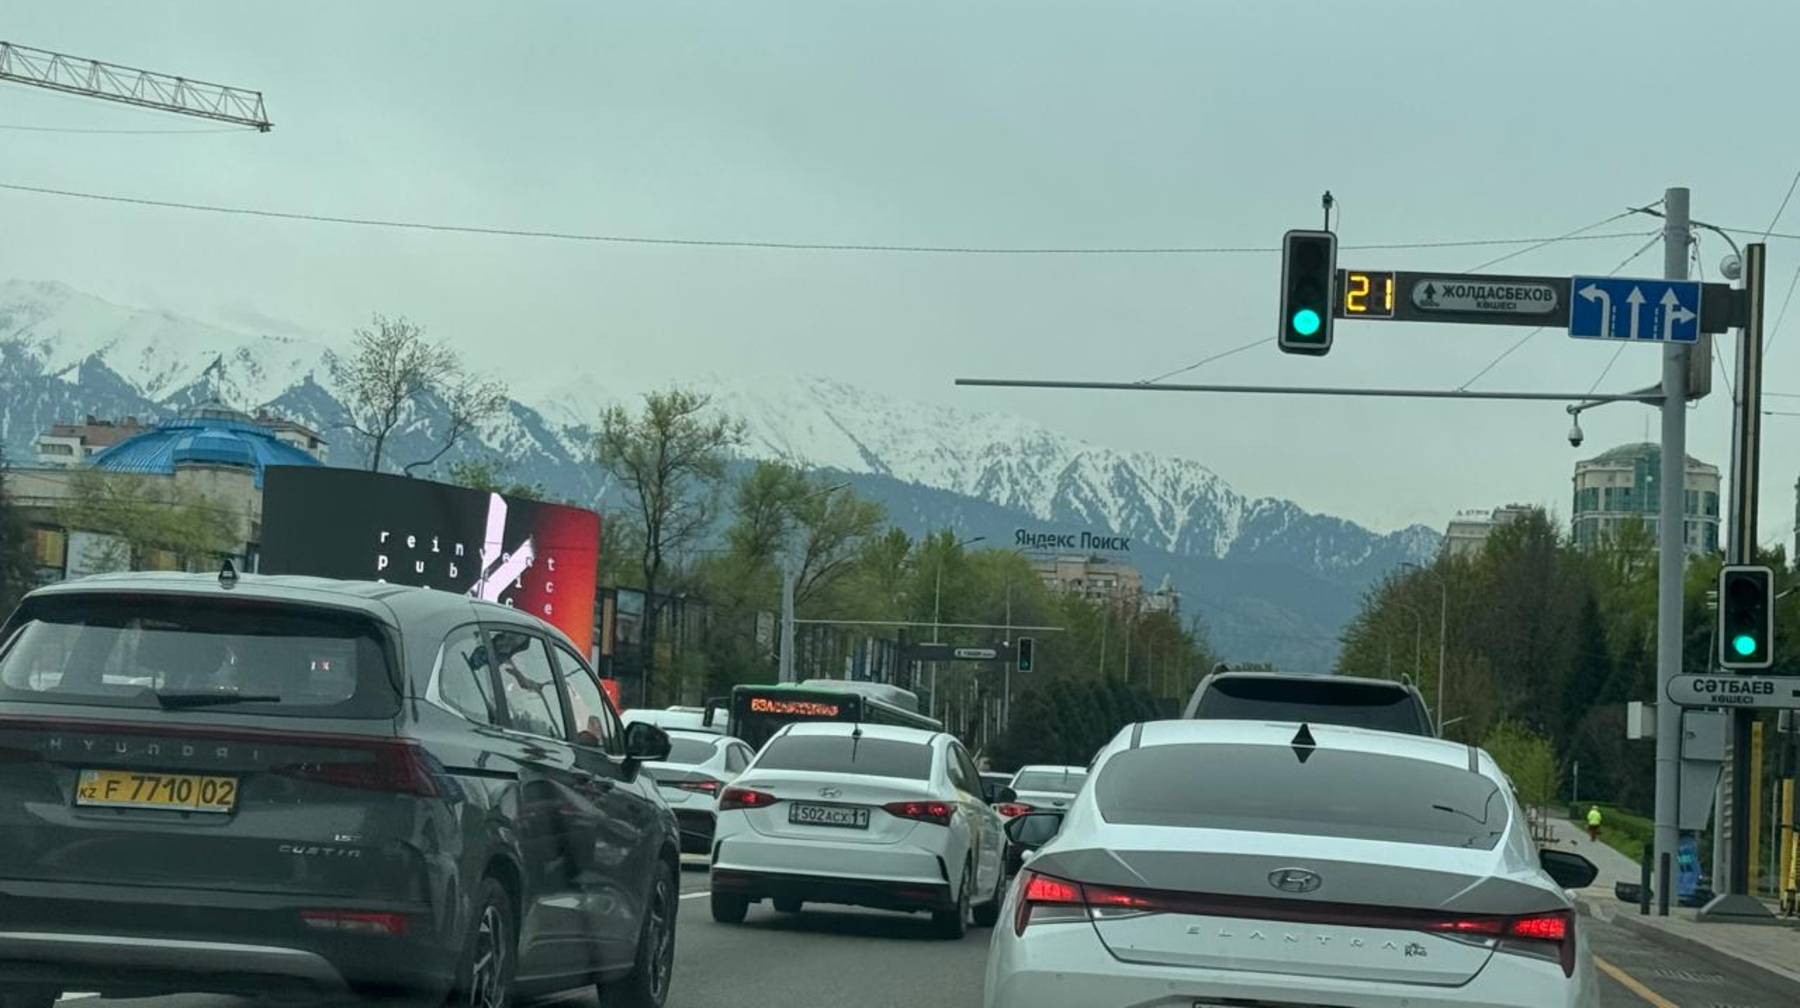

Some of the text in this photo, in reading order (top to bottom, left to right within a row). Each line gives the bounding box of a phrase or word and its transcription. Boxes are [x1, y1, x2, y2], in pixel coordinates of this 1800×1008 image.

[1346, 275, 1392, 311] 21
[1442, 284, 1553, 302] ЖОЛДАСБЕКОВ
[1015, 528, 1131, 551] Яндекс Поиск
[1693, 678, 1774, 695] СӘТБАЕВ
[50, 739, 259, 761] HYUNDAI
[78, 775, 235, 806] KZ F 7710 02
[1187, 925, 1397, 951] ELANTRA
